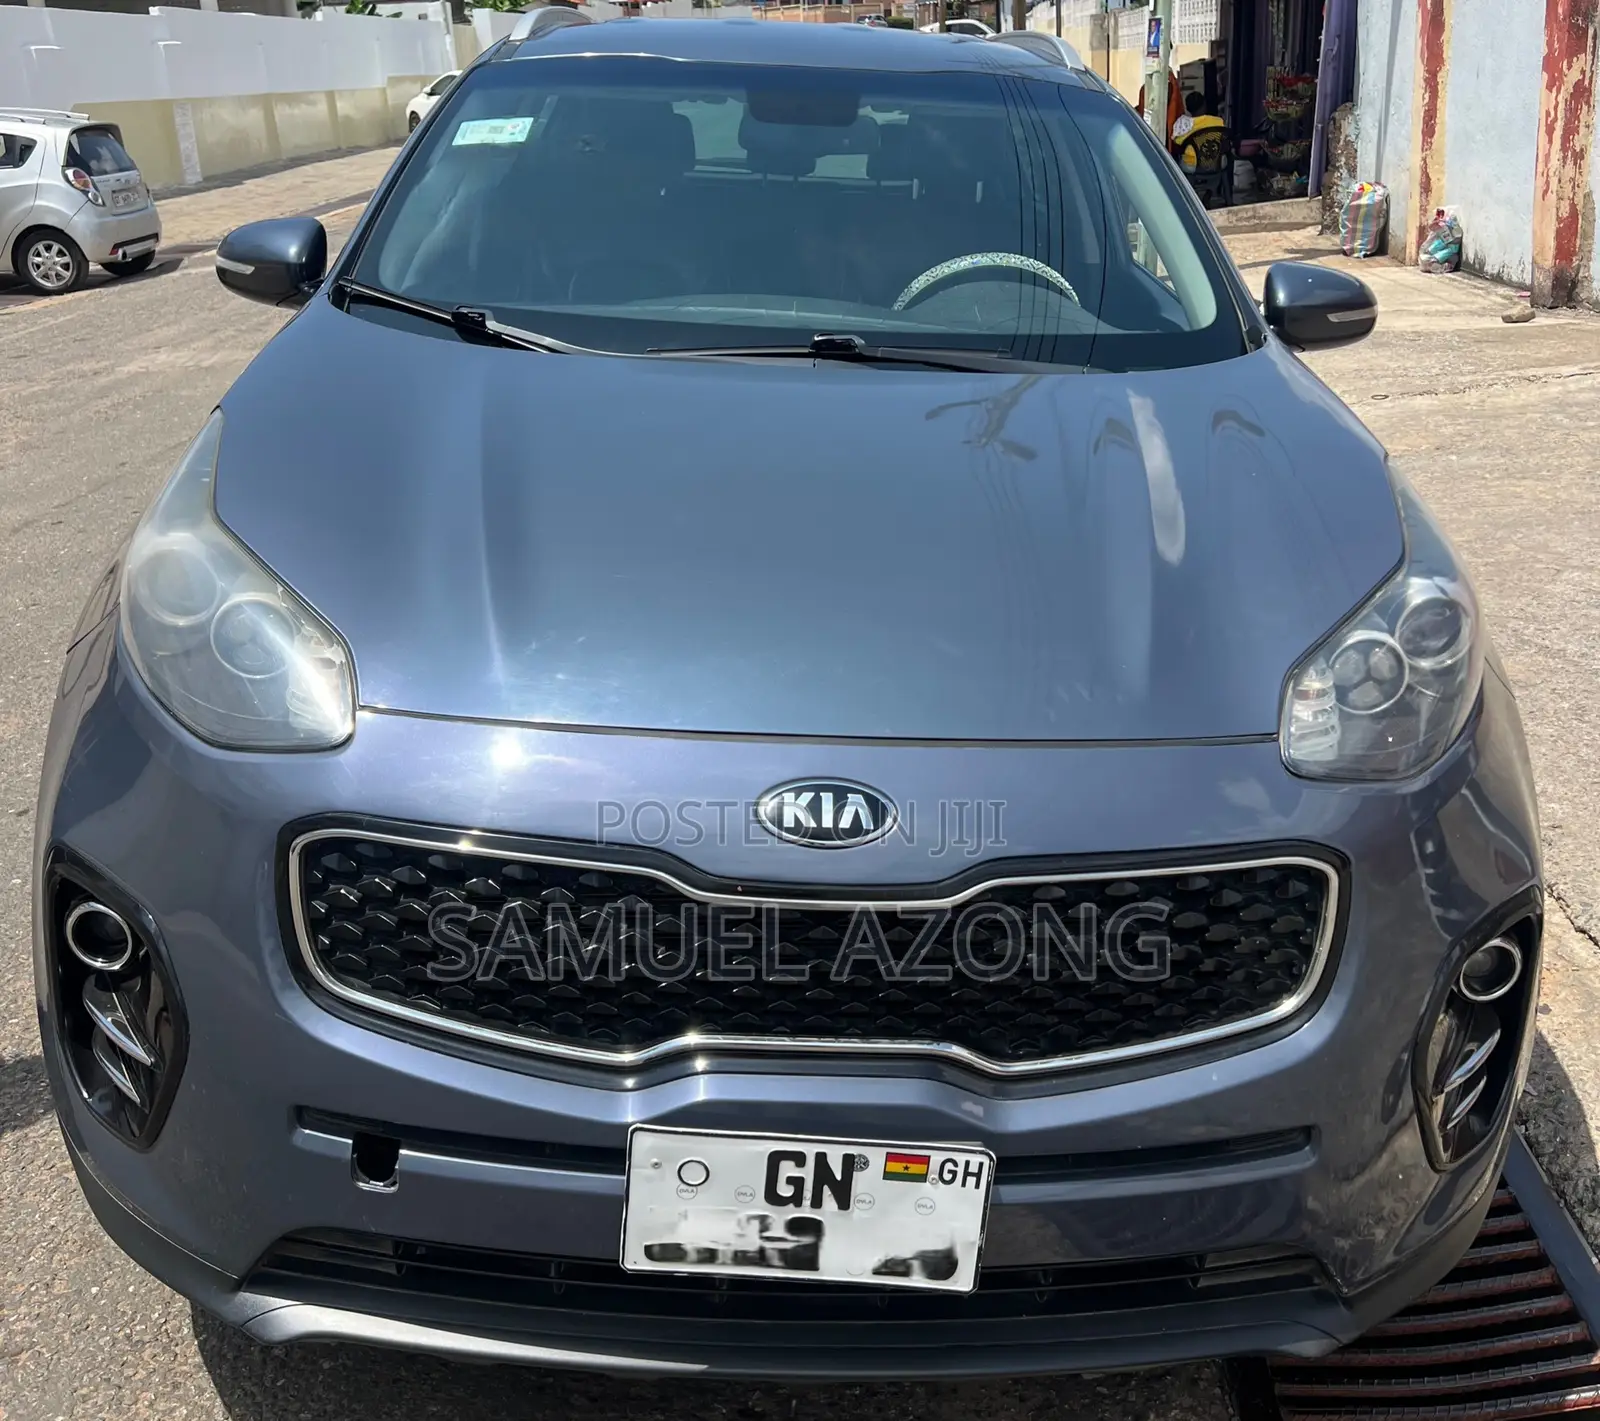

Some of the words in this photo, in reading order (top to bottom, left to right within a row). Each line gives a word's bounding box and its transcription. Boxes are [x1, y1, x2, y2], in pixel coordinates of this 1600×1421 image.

[782, 792, 875, 830] KIA
[764, 1149, 856, 1212] GN
[938, 1157, 985, 1190] GH
